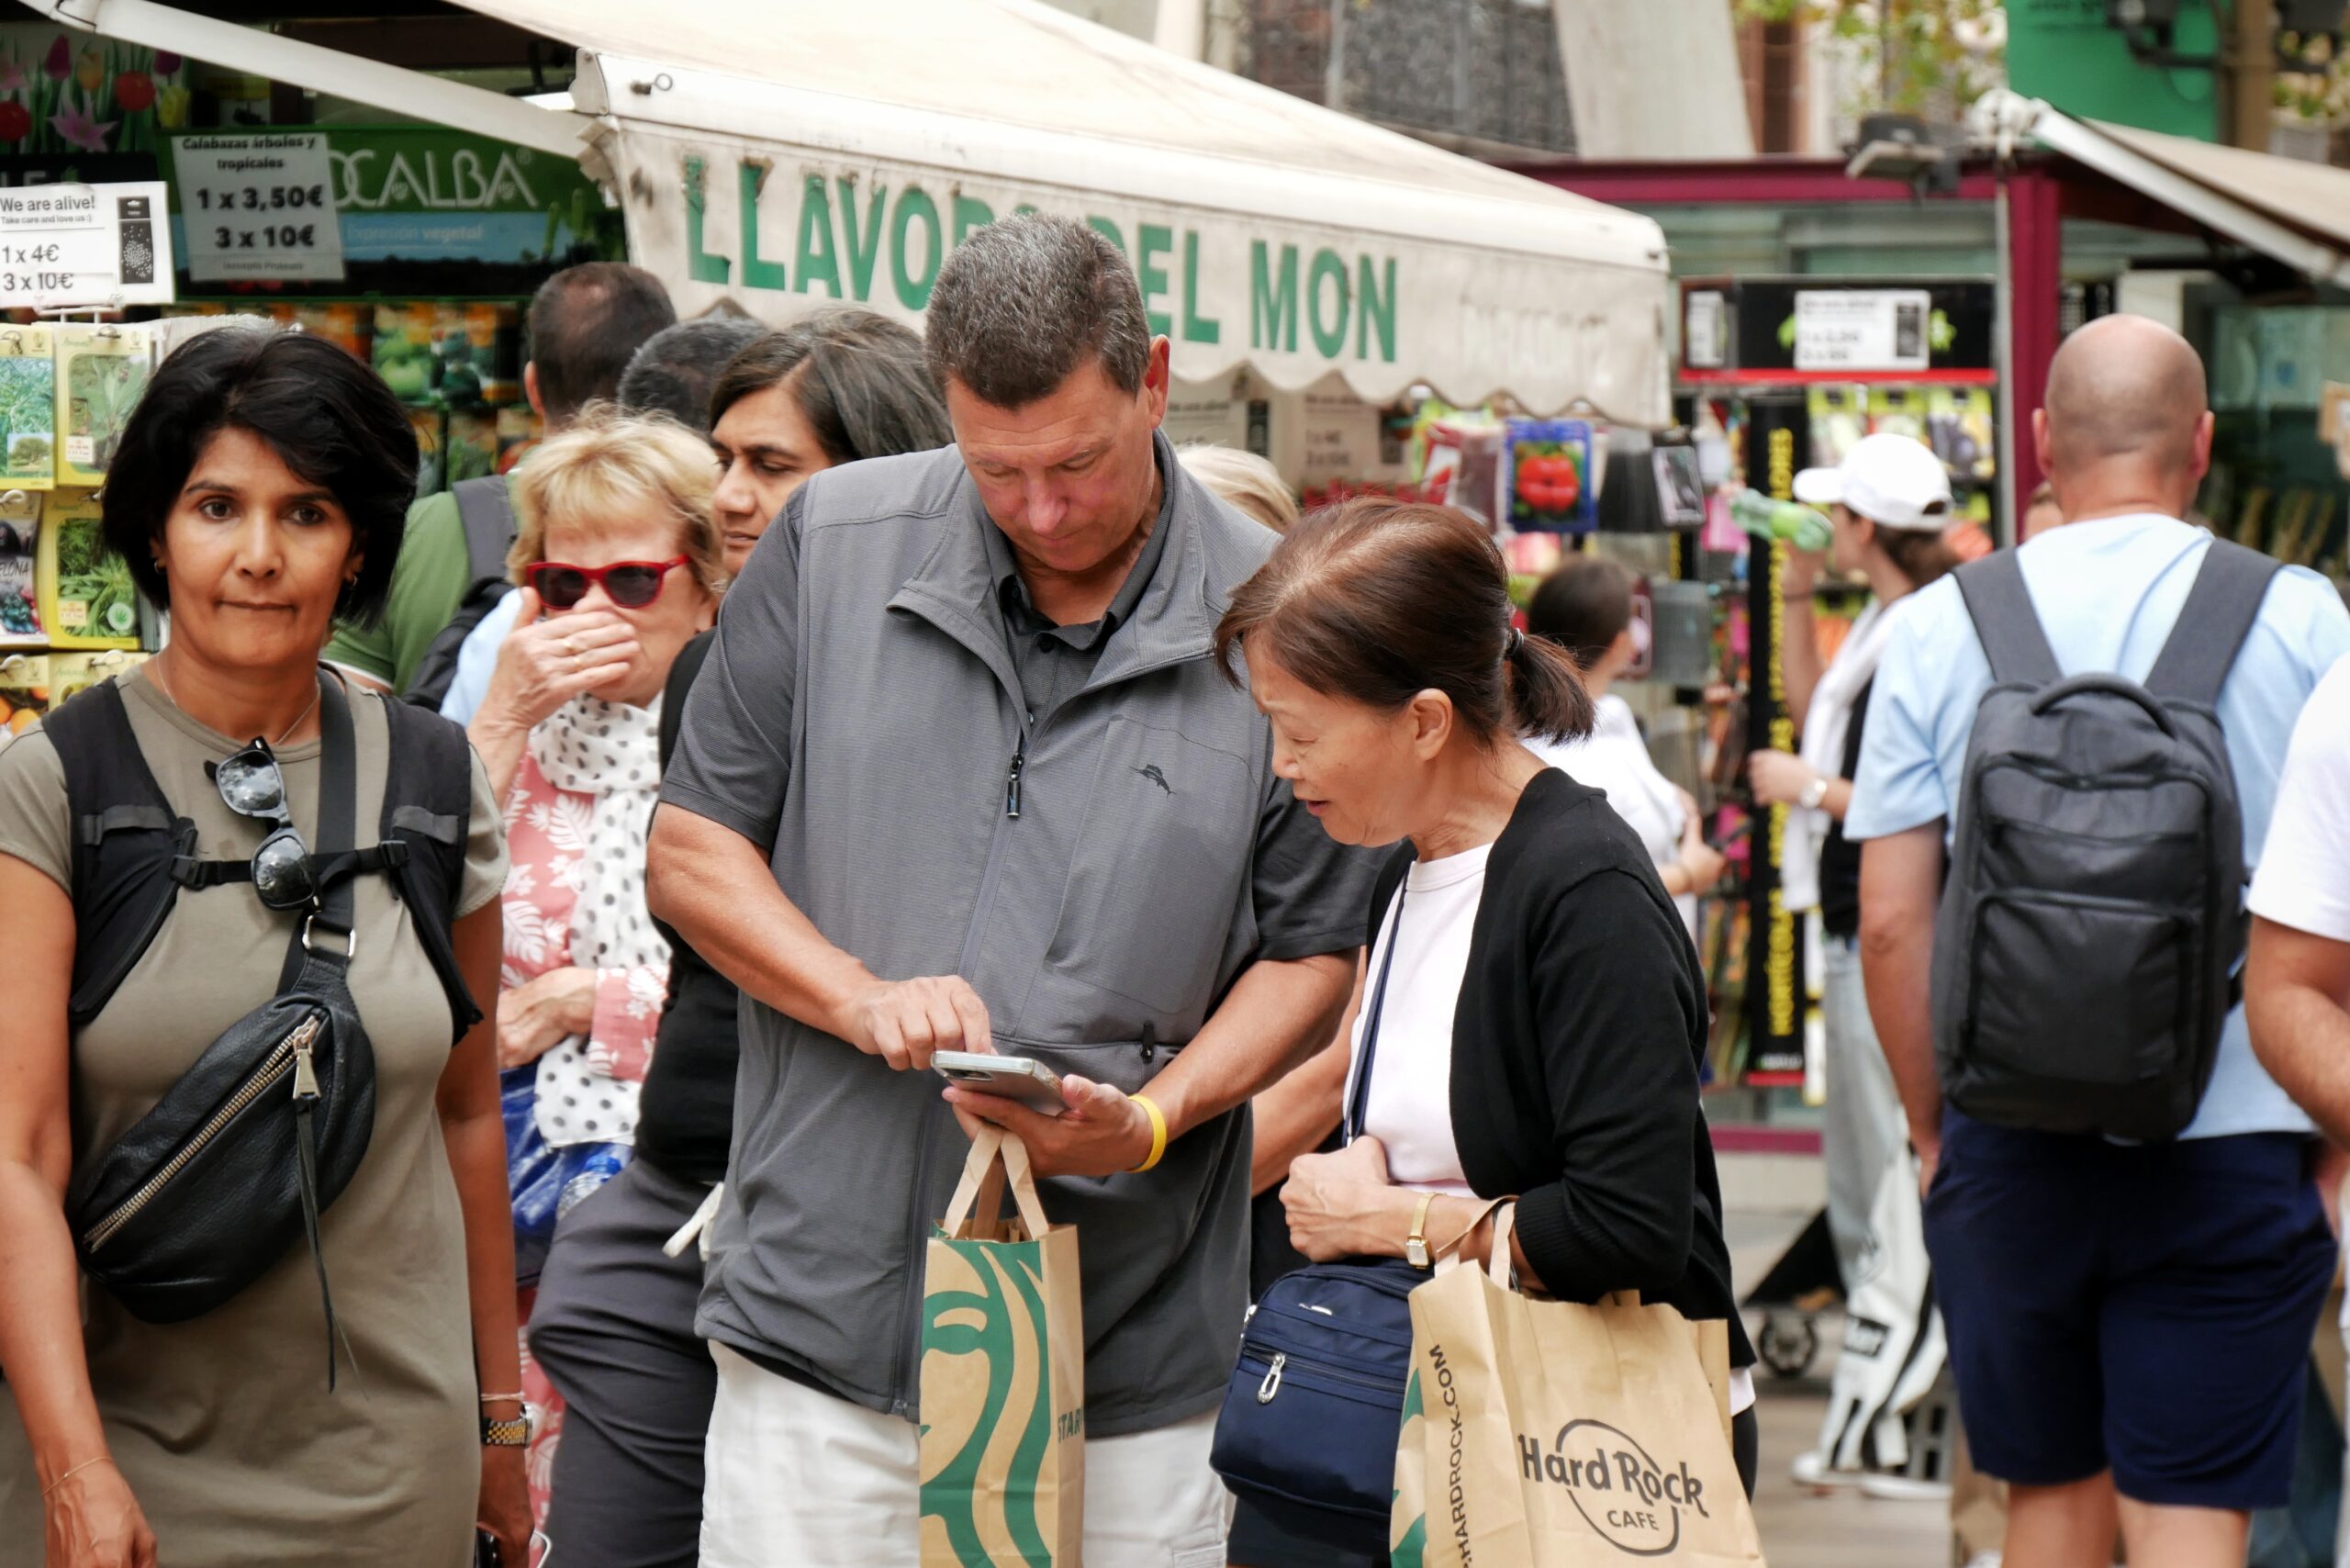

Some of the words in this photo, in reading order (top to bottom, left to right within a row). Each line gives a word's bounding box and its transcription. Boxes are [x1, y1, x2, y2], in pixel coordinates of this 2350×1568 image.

[183, 137, 249, 151] Calabazas
[252, 136, 304, 150] árboles
[307, 137, 316, 149] y
[217, 157, 285, 173] tropicales
[0, 196, 24, 213] We
[27, 199, 51, 212] are
[54, 194, 95, 211] alive!
[196, 187, 209, 209] 1
[218, 191, 235, 209] x
[241, 184, 323, 212] 3,50€
[1, 216, 20, 226] Take
[21, 216, 39, 225] care
[40, 215, 56, 225] and
[56, 214, 74, 224] love
[74, 214, 85, 223] us
[215, 225, 231, 249] 3
[238, 230, 253, 248] x
[262, 223, 315, 248] 10€
[421, 223, 485, 243] vegetal
[2, 245, 10, 264] 1
[16, 249, 27, 263] x
[31, 243, 60, 263] 4€
[682, 152, 1040, 312] LLAVO
[1250, 237, 1396, 363] MON
[3, 273, 16, 292] 3
[20, 276, 32, 291] x
[38, 272, 74, 290] 10€
[1057, 1404, 1084, 1444] STAR
[1517, 1433, 1612, 1491] Hard
[1612, 1450, 1710, 1518] Rock
[1606, 1509, 1660, 1531] CAFE
